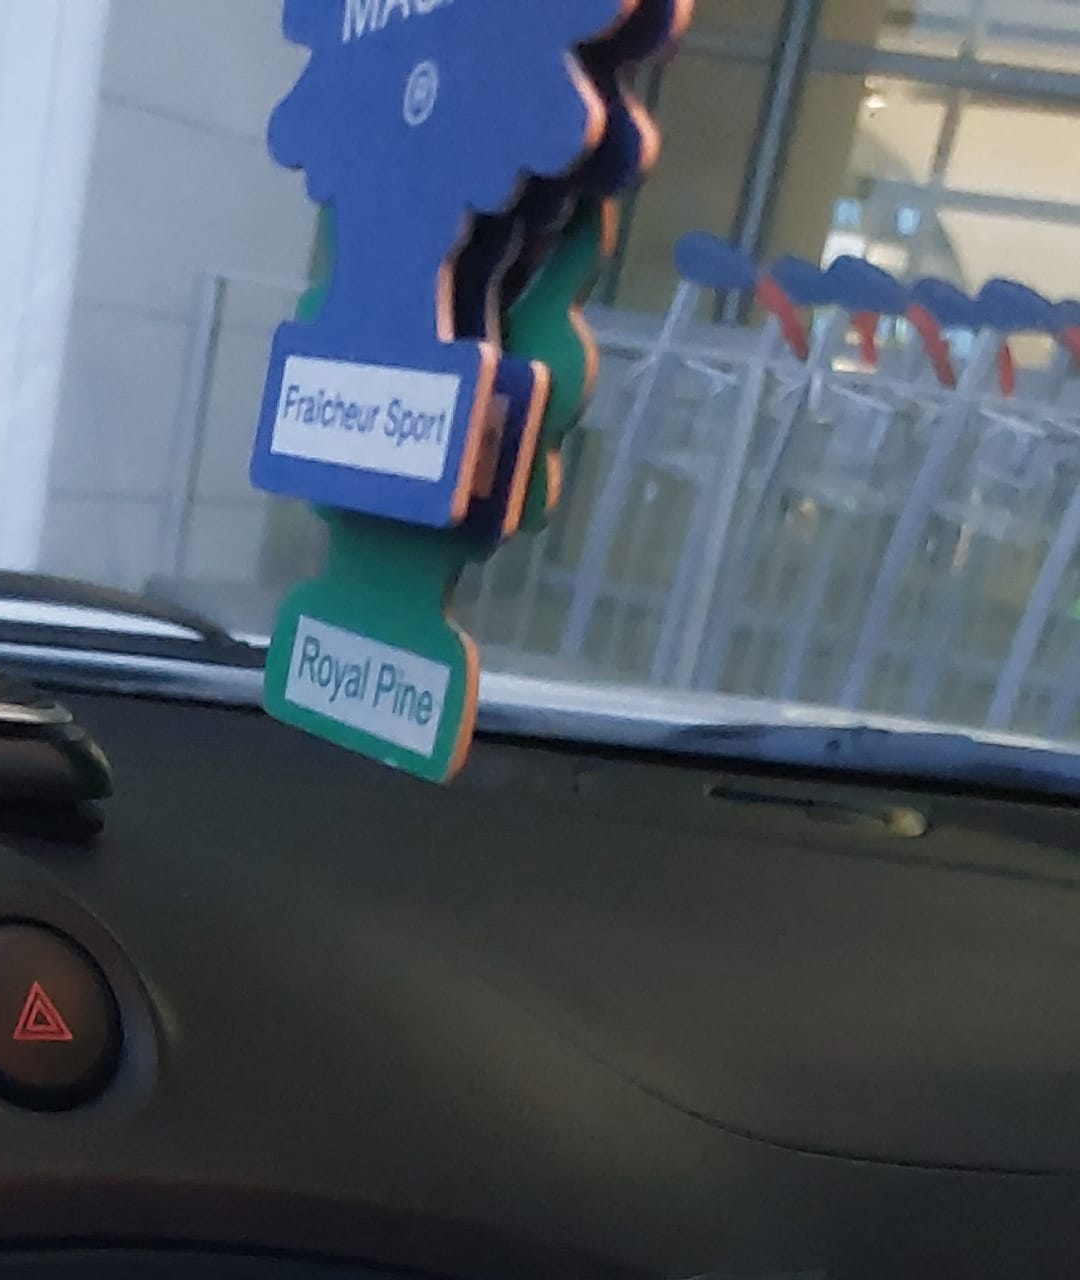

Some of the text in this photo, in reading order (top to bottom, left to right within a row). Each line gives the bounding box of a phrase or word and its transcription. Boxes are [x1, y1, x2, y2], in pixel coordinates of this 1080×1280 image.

[383, 397, 447, 447] Sport
[297, 634, 434, 726] Royal Pine
